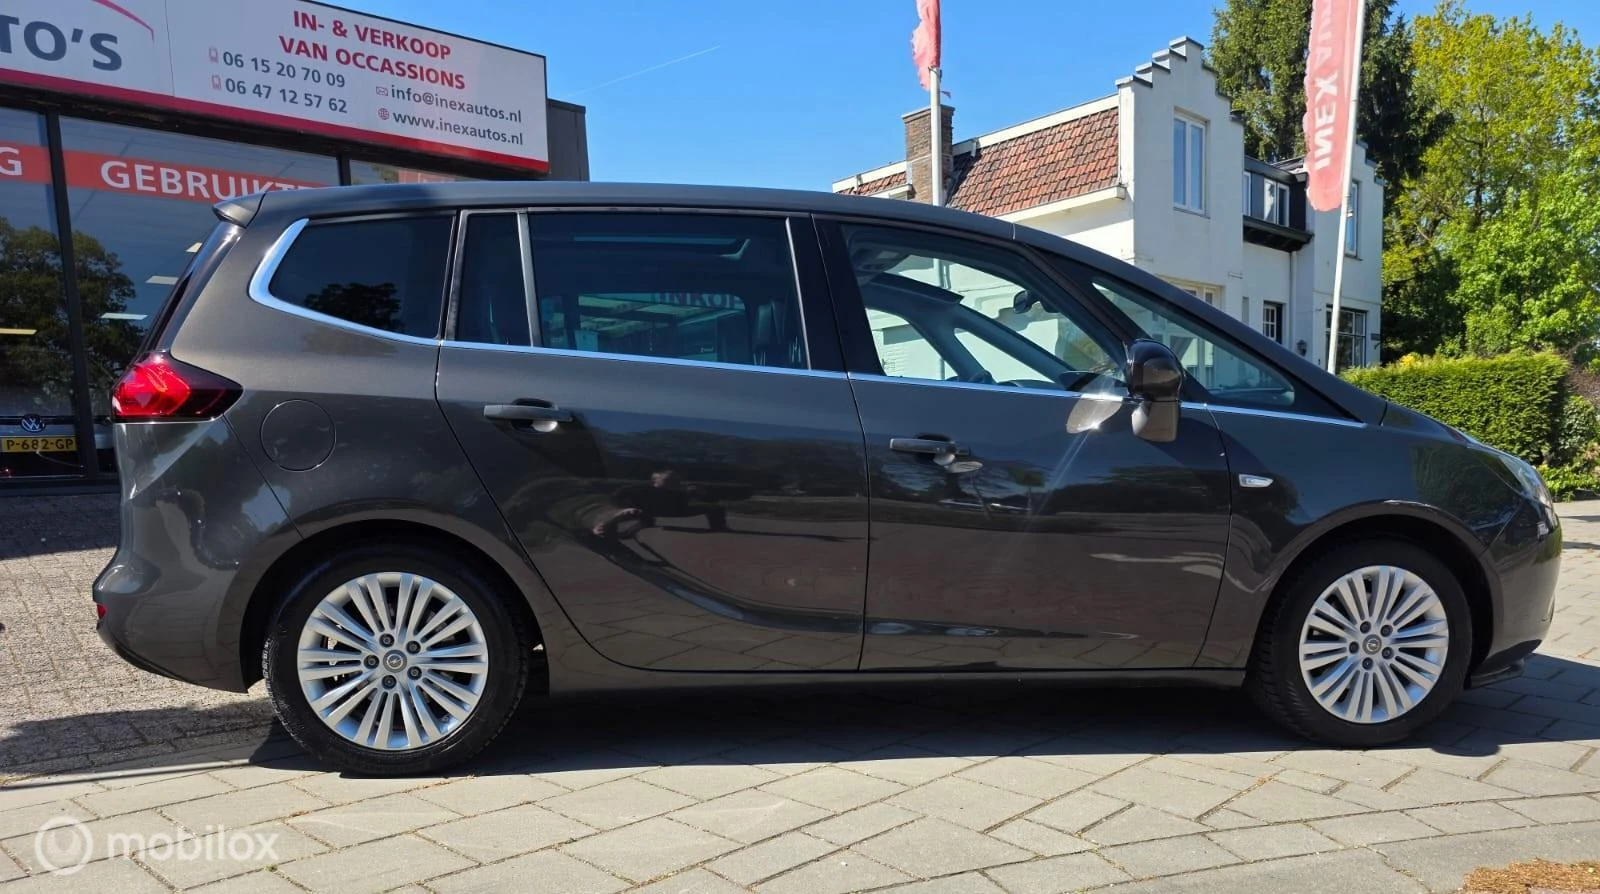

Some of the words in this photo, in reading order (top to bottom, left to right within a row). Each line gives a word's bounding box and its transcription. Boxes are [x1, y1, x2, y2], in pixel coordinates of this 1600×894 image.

[293, 11, 325, 31] IN-
[332, 20, 348, 38] &
[354, 24, 451, 60] VERKOOP
[223, 52, 244, 68] 06
[251, 57, 270, 73] 15
[276, 62, 296, 78] 20
[301, 67, 321, 83] 70
[326, 72, 345, 87] 09
[279, 35, 328, 61] VAN
[336, 48, 466, 90] OCCASSIONS
[225, 78, 246, 94] 06
[252, 83, 272, 99] 47
[279, 89, 299, 104] 12
[304, 93, 322, 109] 57
[328, 98, 348, 113] 62
[391, 85, 522, 123] info@inexautos.nl
[392, 112, 524, 145] www.inexautos.nl
[1314, 72, 1339, 170] INEX
[6, 439, 74, 451] P-682-GP
